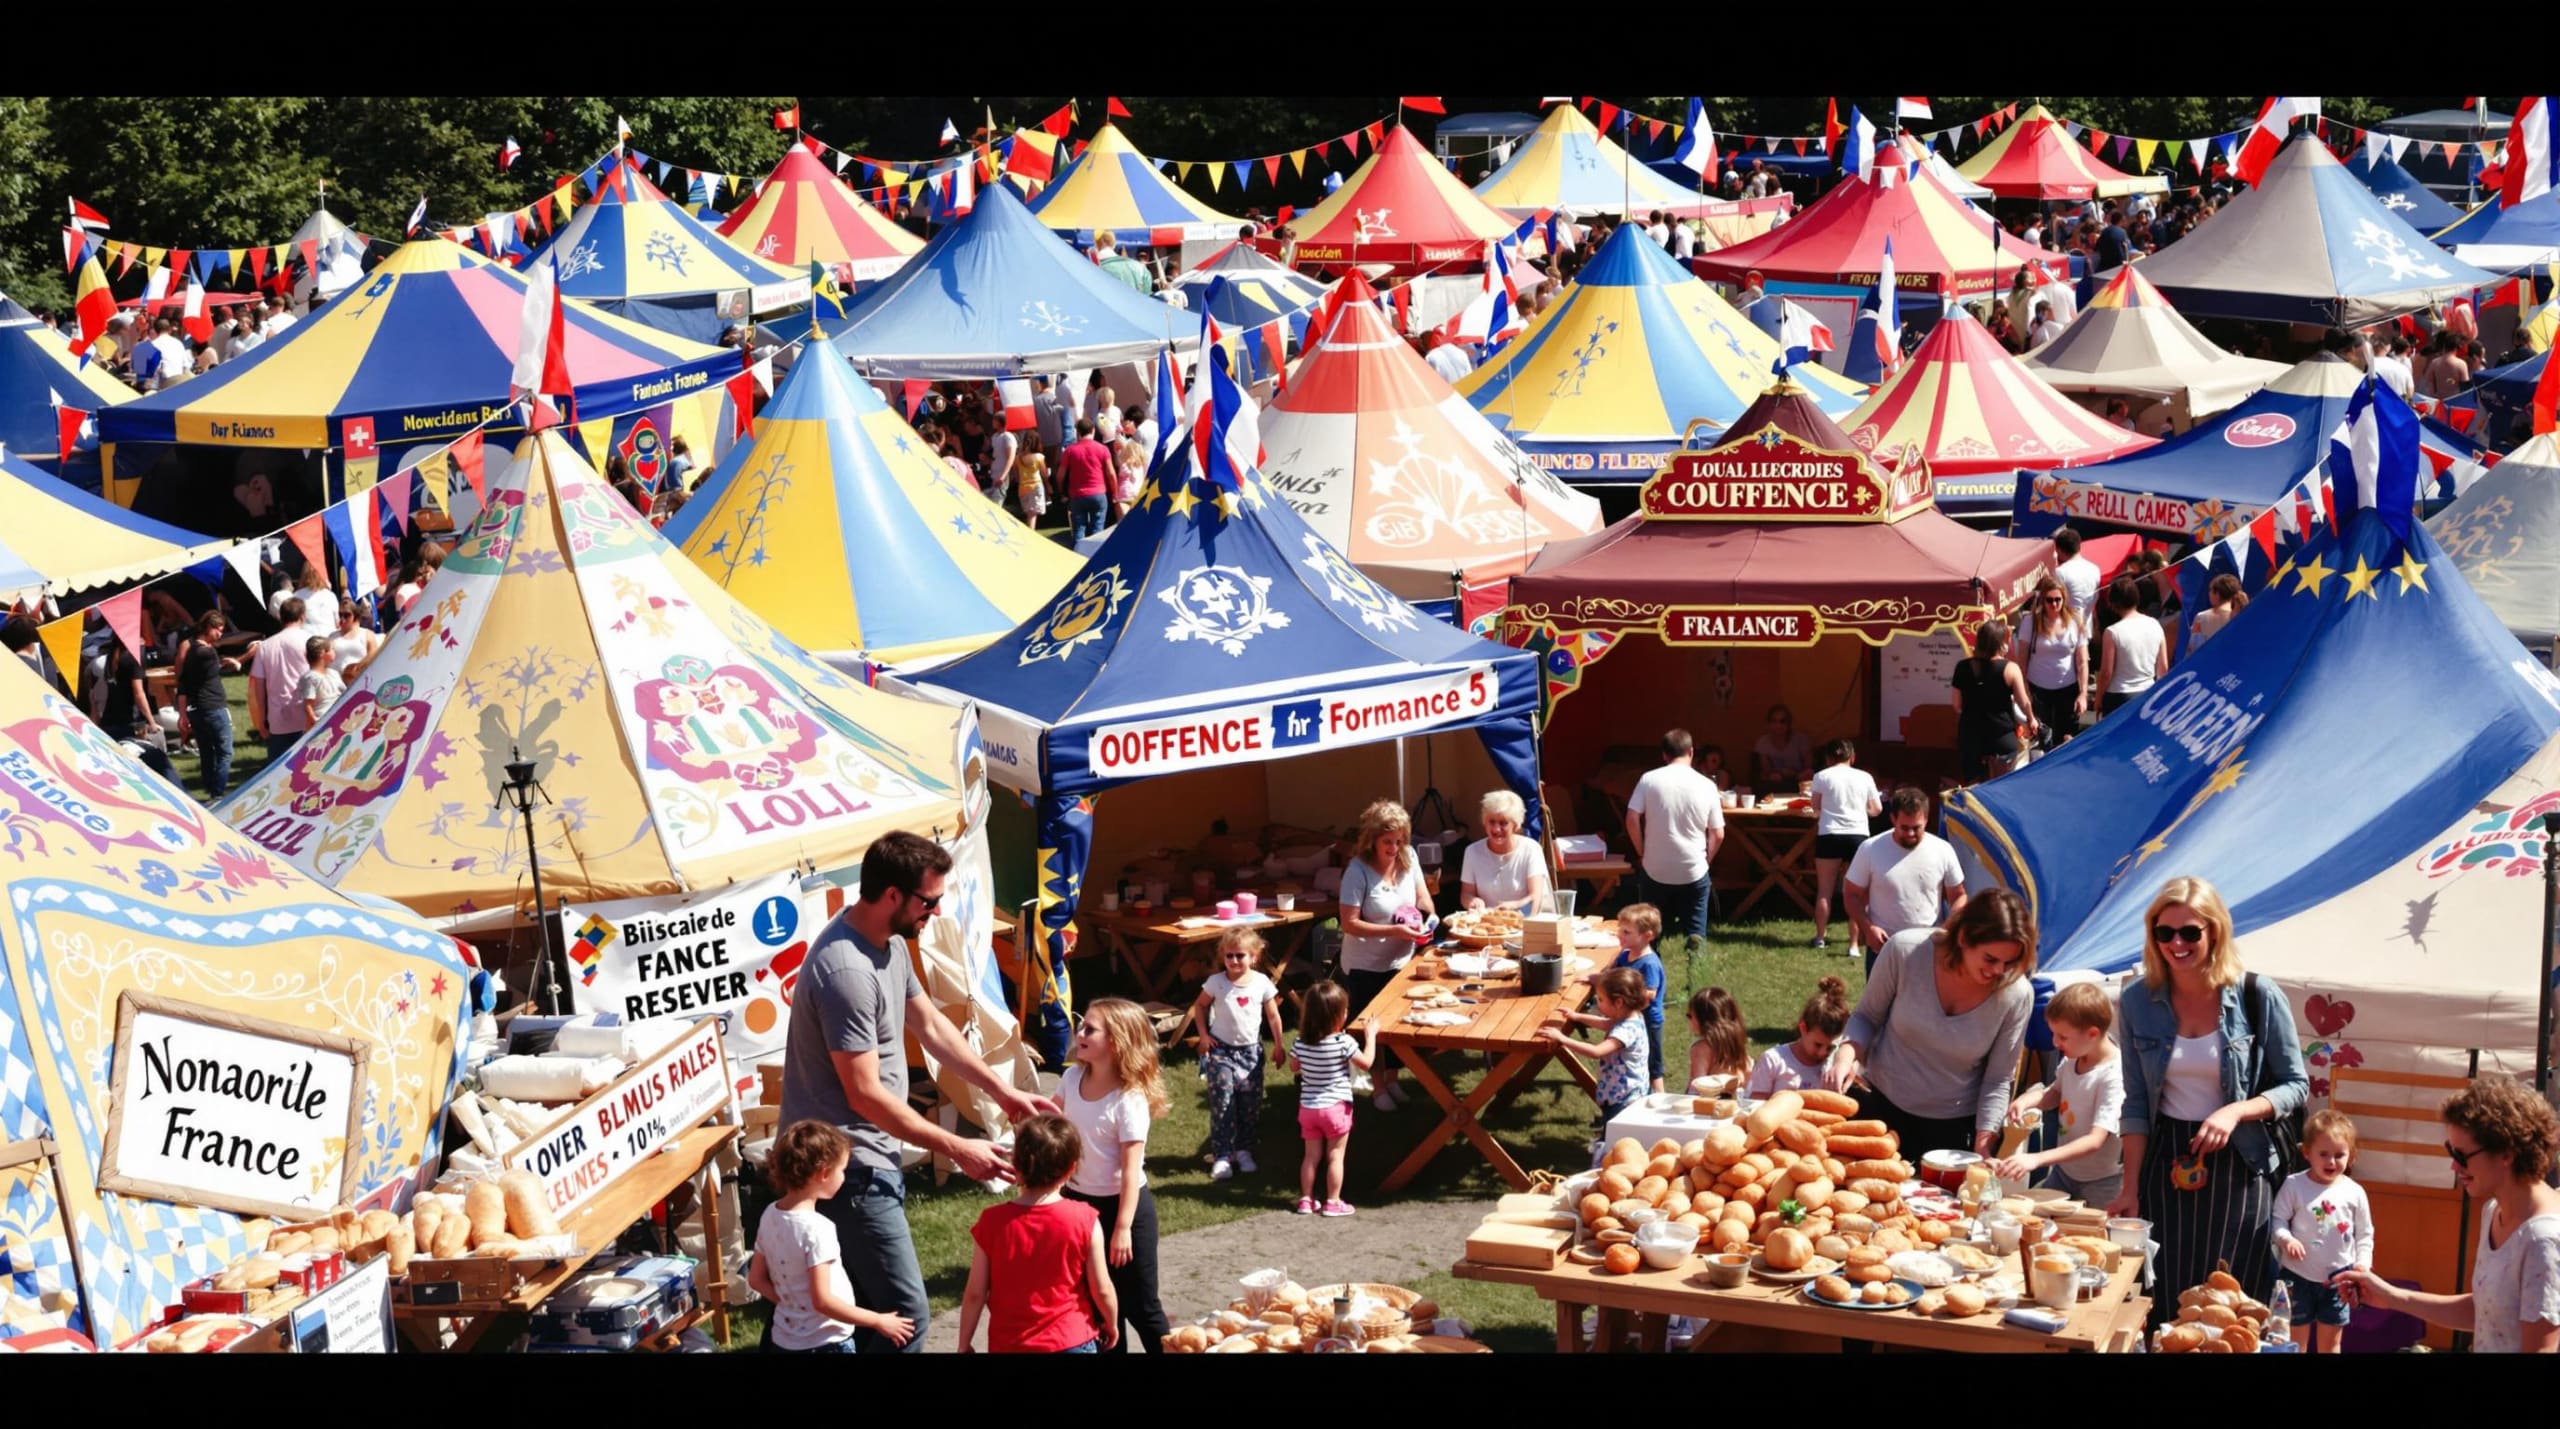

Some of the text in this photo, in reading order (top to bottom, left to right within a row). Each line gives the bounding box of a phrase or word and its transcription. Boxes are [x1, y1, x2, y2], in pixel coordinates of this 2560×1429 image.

[1692, 462, 1748, 479] LOUAL
[1666, 482, 1849, 509] COUFFENCE
[2134, 501, 2187, 529] CAMES
[1681, 615, 1799, 637] FRALANCE
[1329, 690, 1461, 735] Formance
[1469, 671, 1488, 708] 5
[725, 782, 872, 835] LOLL
[712, 907, 736, 929] de
[637, 938, 730, 983] FANCE
[625, 971, 749, 1022] RESEVER
[161, 1106, 300, 1180] France
